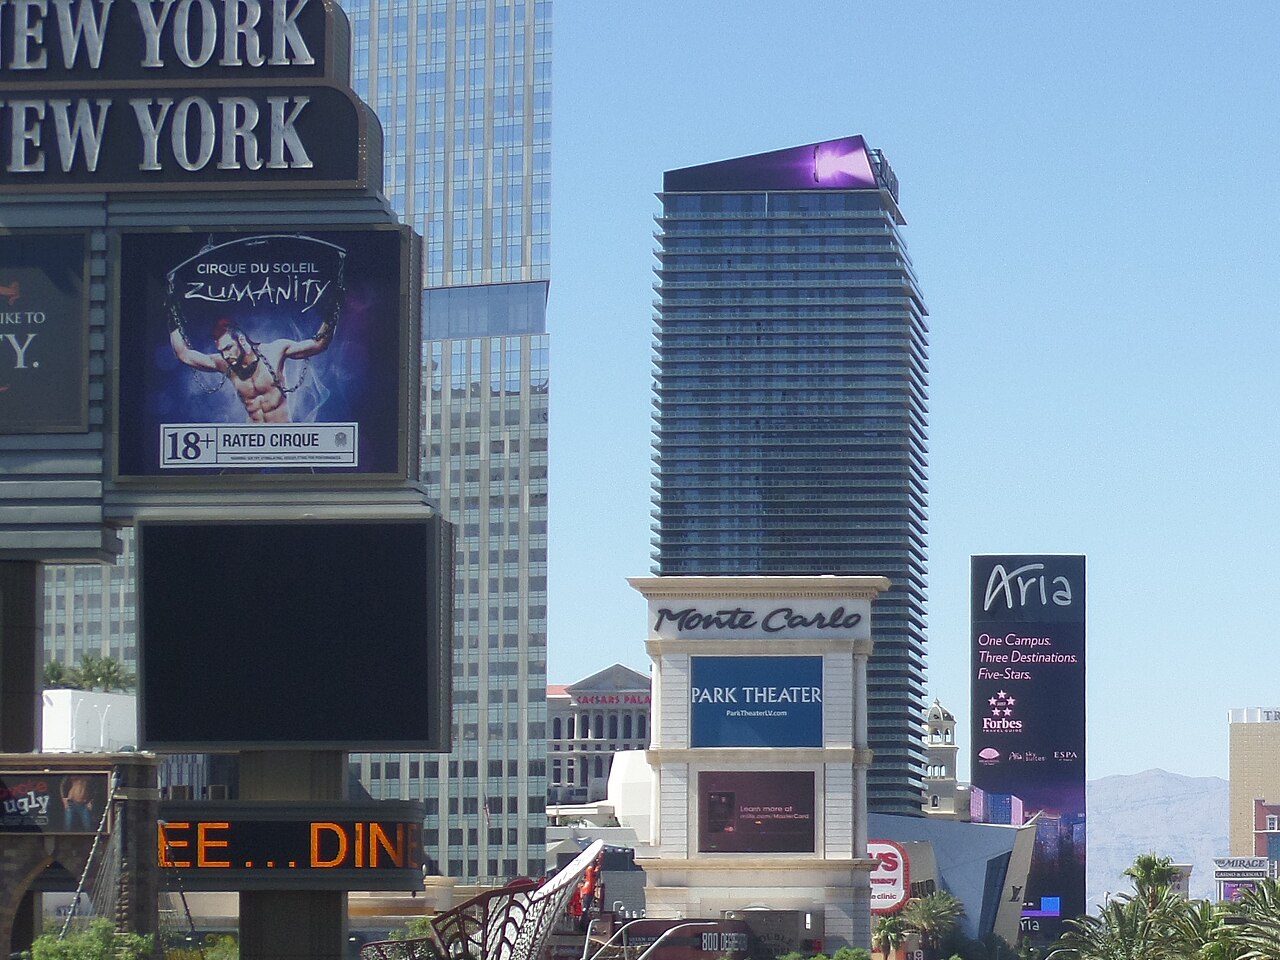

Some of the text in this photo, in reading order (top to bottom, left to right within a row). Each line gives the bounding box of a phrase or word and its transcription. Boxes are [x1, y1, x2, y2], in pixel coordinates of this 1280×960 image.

[0, 0, 315, 71] EW YORK
[0, 96, 314, 172] EW YORK
[197, 262, 319, 277] CIRQUE DU SOLEIL
[25, 311, 46, 324] TO
[167, 430, 215, 460] 18+
[222, 433, 320, 448] RATED CIRQUE
[983, 563, 1073, 612] Aria
[654, 606, 862, 633] Monte Carlo
[978, 634, 1052, 648] One Campus.
[978, 651, 1078, 663] Three Destinations.
[977, 668, 1032, 680] Five-Stars.
[576, 695, 620, 704] CAESARS
[691, 687, 822, 703] PARK THEATER
[726, 709, 788, 718] ParkTheaterLV.com
[982, 717, 1023, 729] Forbes
[1053, 751, 1078, 759] ESPA
[4, 790, 50, 813] ugly
[1222, 859, 1266, 869] MIRAGE
[877, 892, 897, 900] clinic
[1020, 917, 1041, 931] ria
[702, 933, 718, 951] 800
